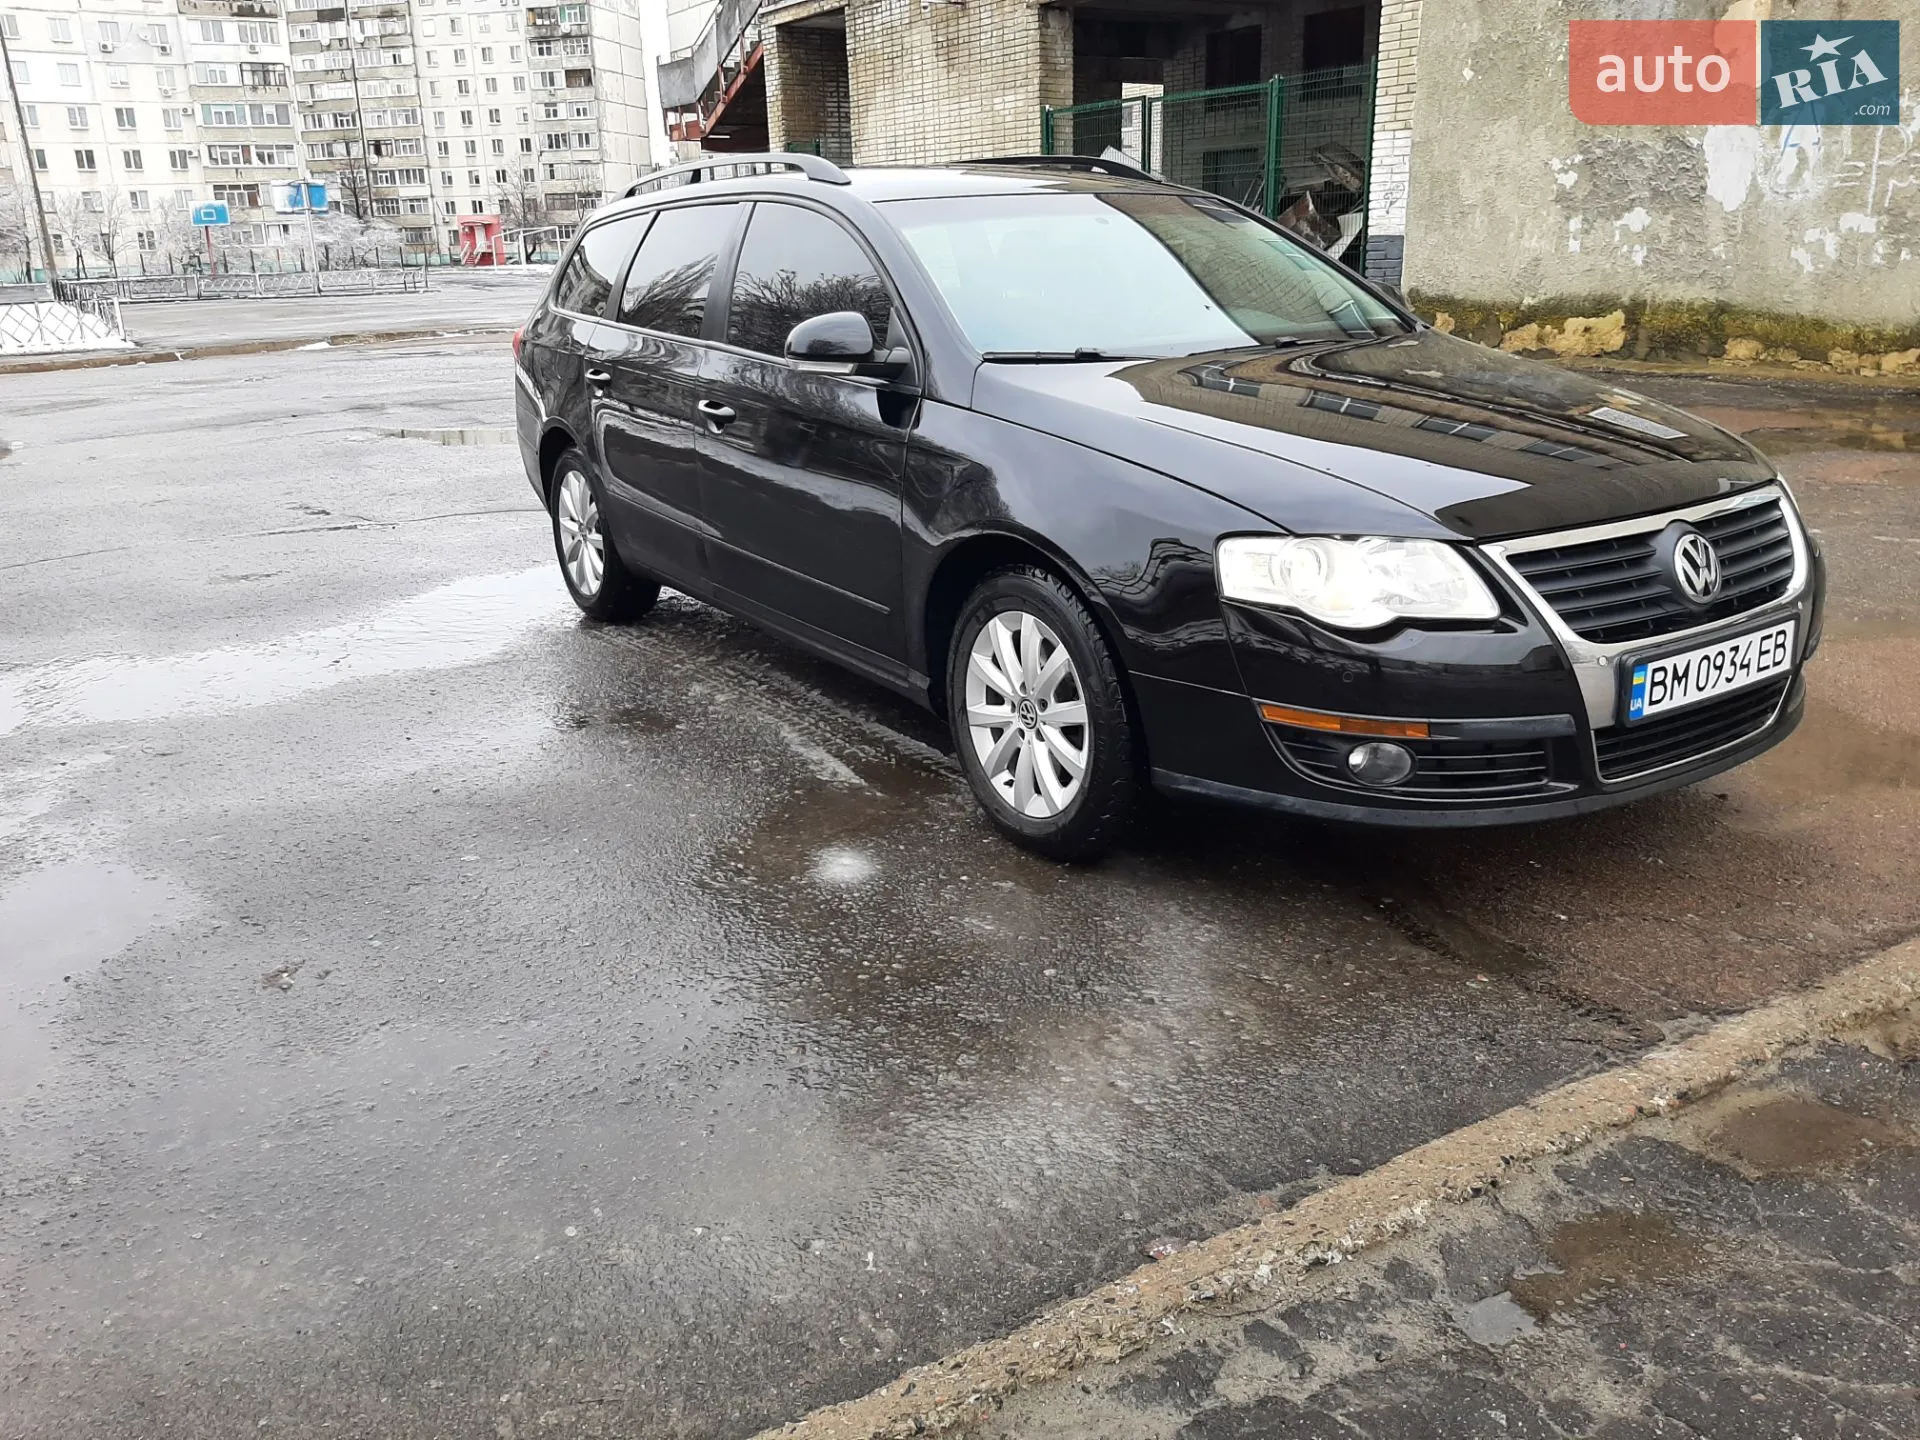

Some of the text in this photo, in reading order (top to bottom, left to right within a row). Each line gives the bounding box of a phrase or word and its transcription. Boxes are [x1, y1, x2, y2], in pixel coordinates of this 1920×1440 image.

[1648, 629, 1787, 707] BM 0934 EB
[1630, 698, 1643, 711] UA
